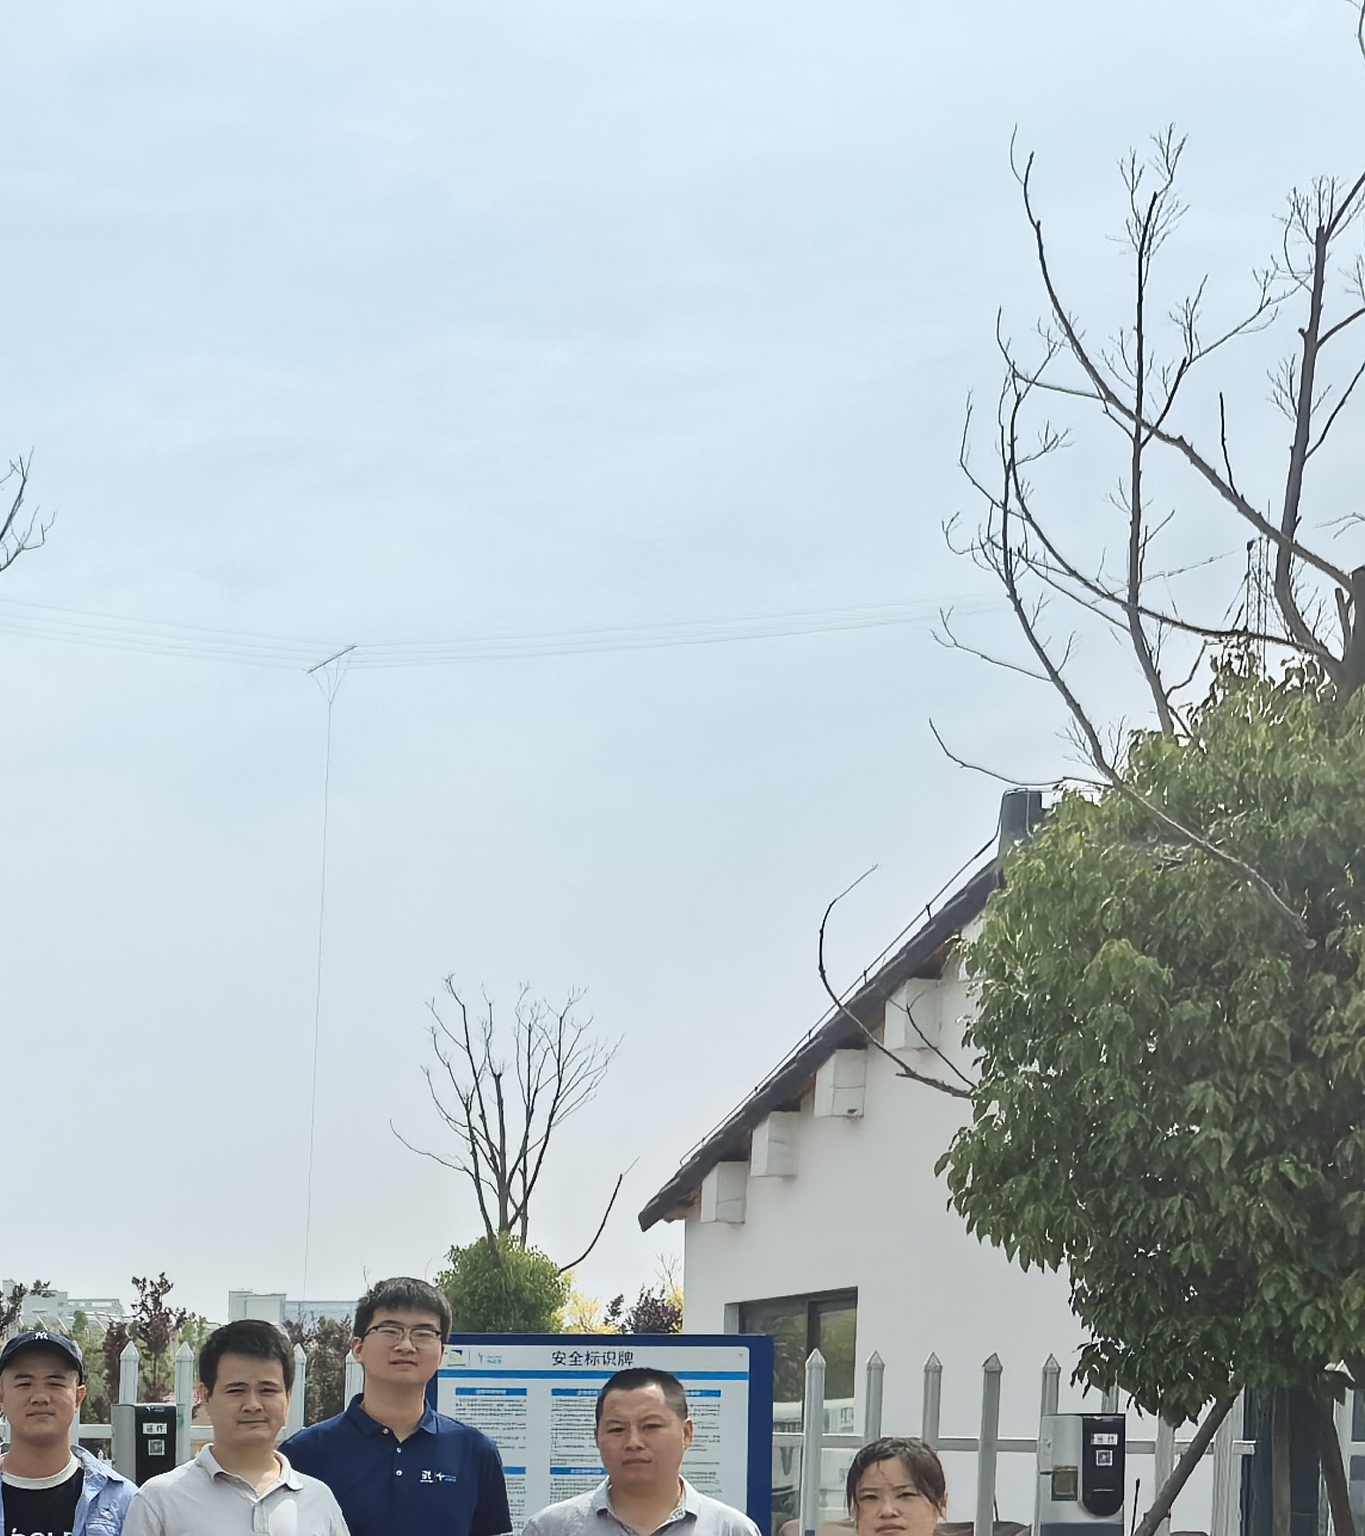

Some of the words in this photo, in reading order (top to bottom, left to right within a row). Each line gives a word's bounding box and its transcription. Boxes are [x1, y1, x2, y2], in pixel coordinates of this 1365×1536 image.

[551, 1350, 634, 1367] 安全标识牌
